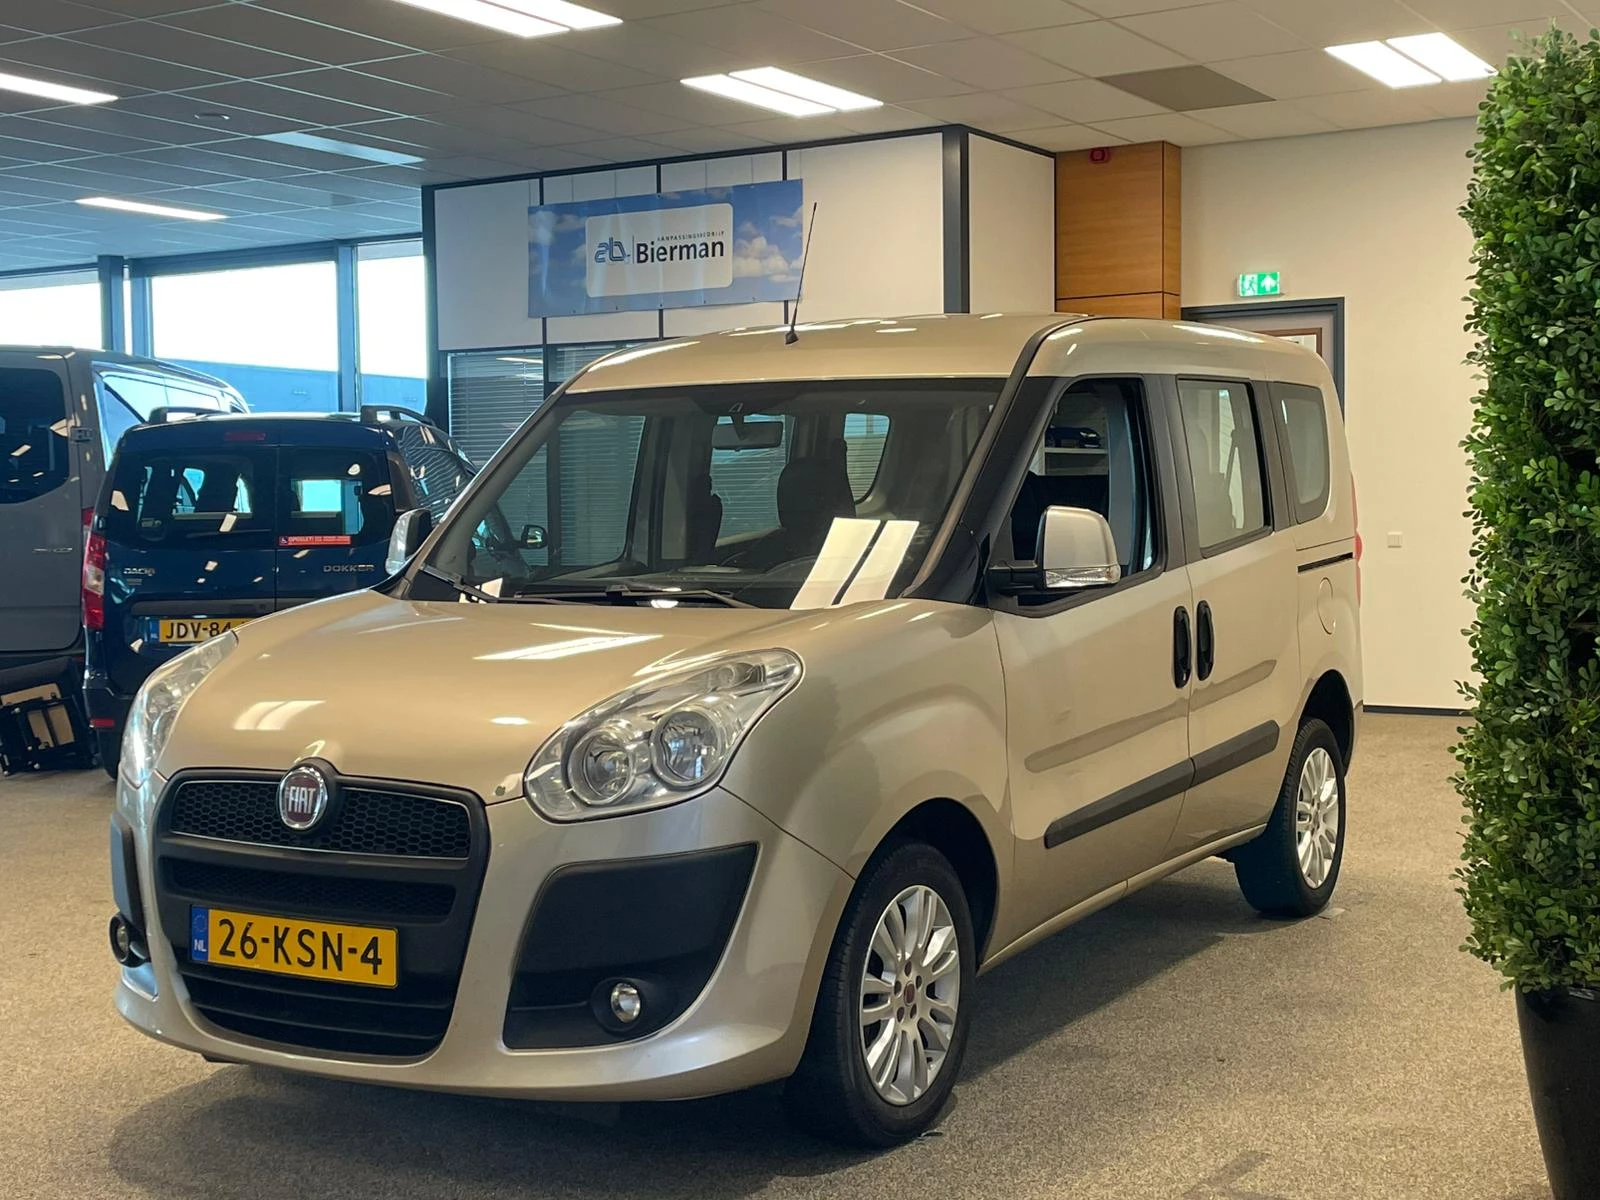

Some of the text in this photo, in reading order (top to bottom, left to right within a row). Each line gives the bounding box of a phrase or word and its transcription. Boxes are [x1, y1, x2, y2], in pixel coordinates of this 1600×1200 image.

[636, 240, 724, 264] Bierman
[323, 564, 375, 573] DOKKER
[166, 621, 245, 639] JDV-84
[288, 785, 316, 814] FIAT
[194, 938, 207, 952] NL
[219, 918, 382, 975] 26-KSN-4
